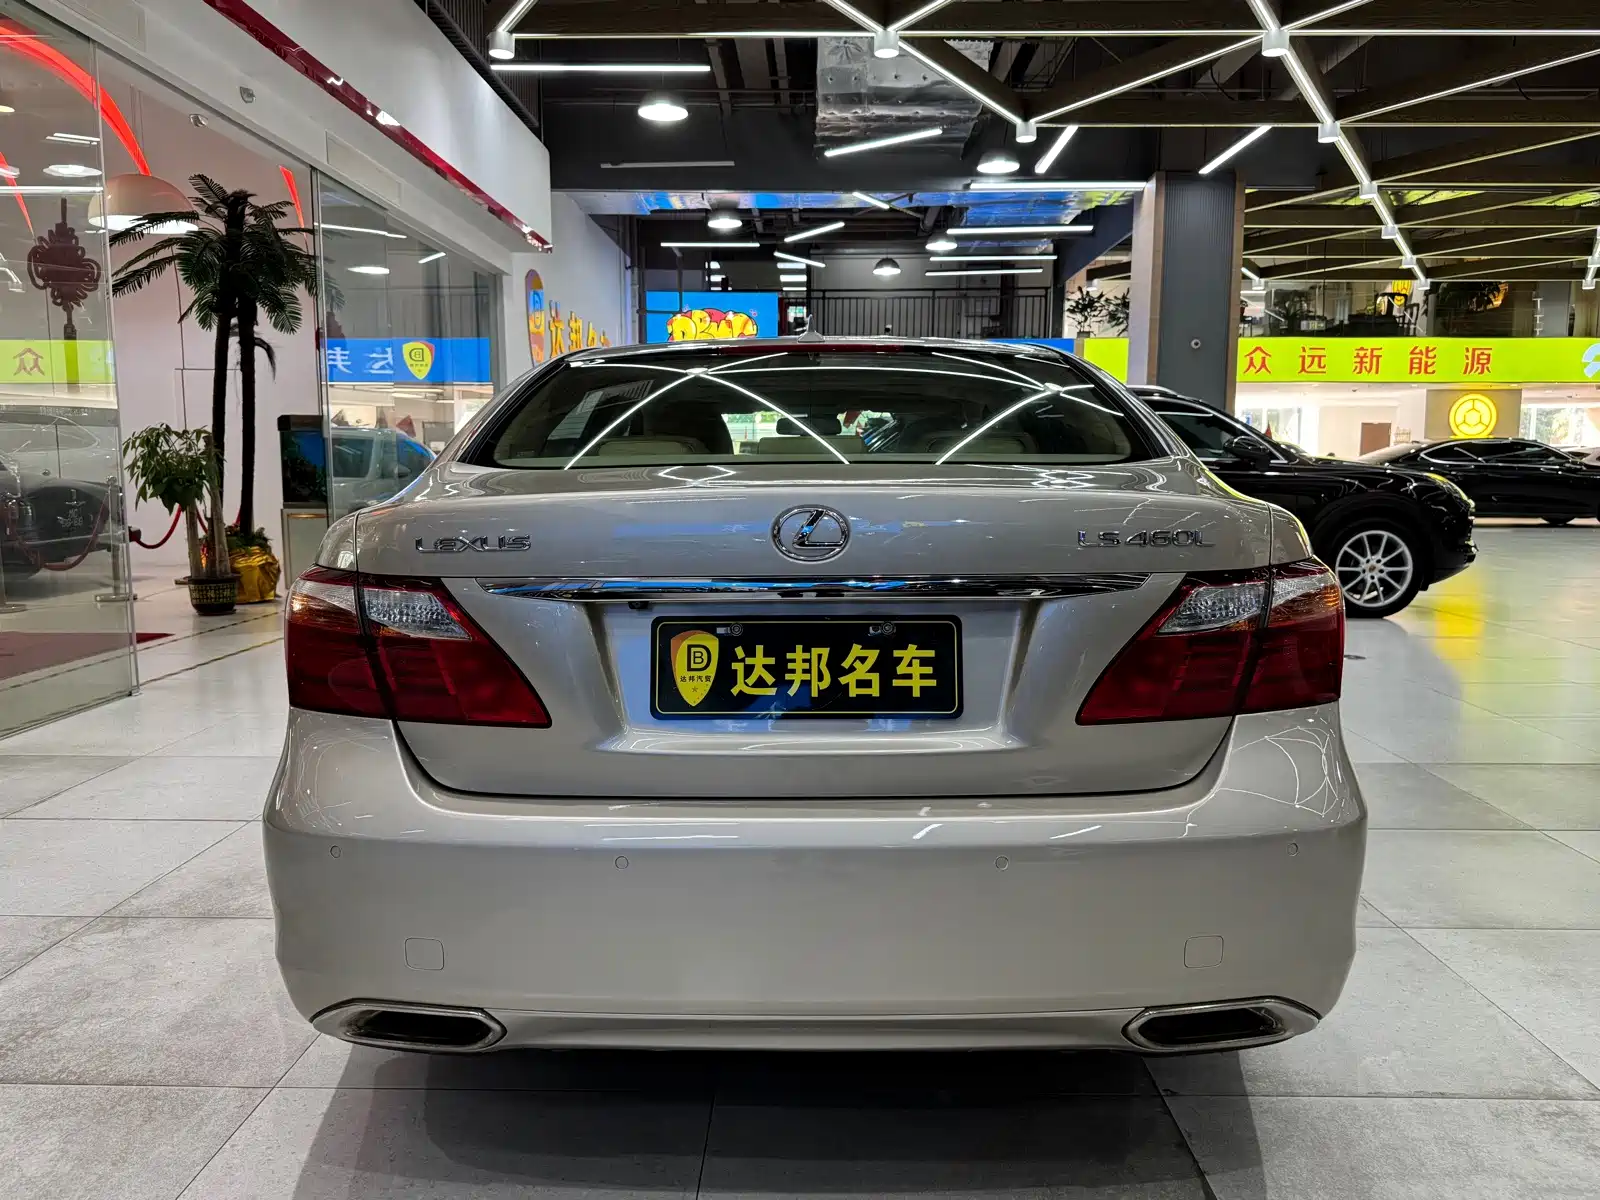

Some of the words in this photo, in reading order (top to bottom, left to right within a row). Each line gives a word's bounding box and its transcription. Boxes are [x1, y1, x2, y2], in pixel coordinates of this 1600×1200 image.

[1243, 346, 1493, 375] 众远新能源
[415, 535, 531, 553] LEXUS
[1078, 530, 1121, 547] LS
[1125, 529, 1216, 547] 460L
[730, 643, 937, 698] 达邦名车
